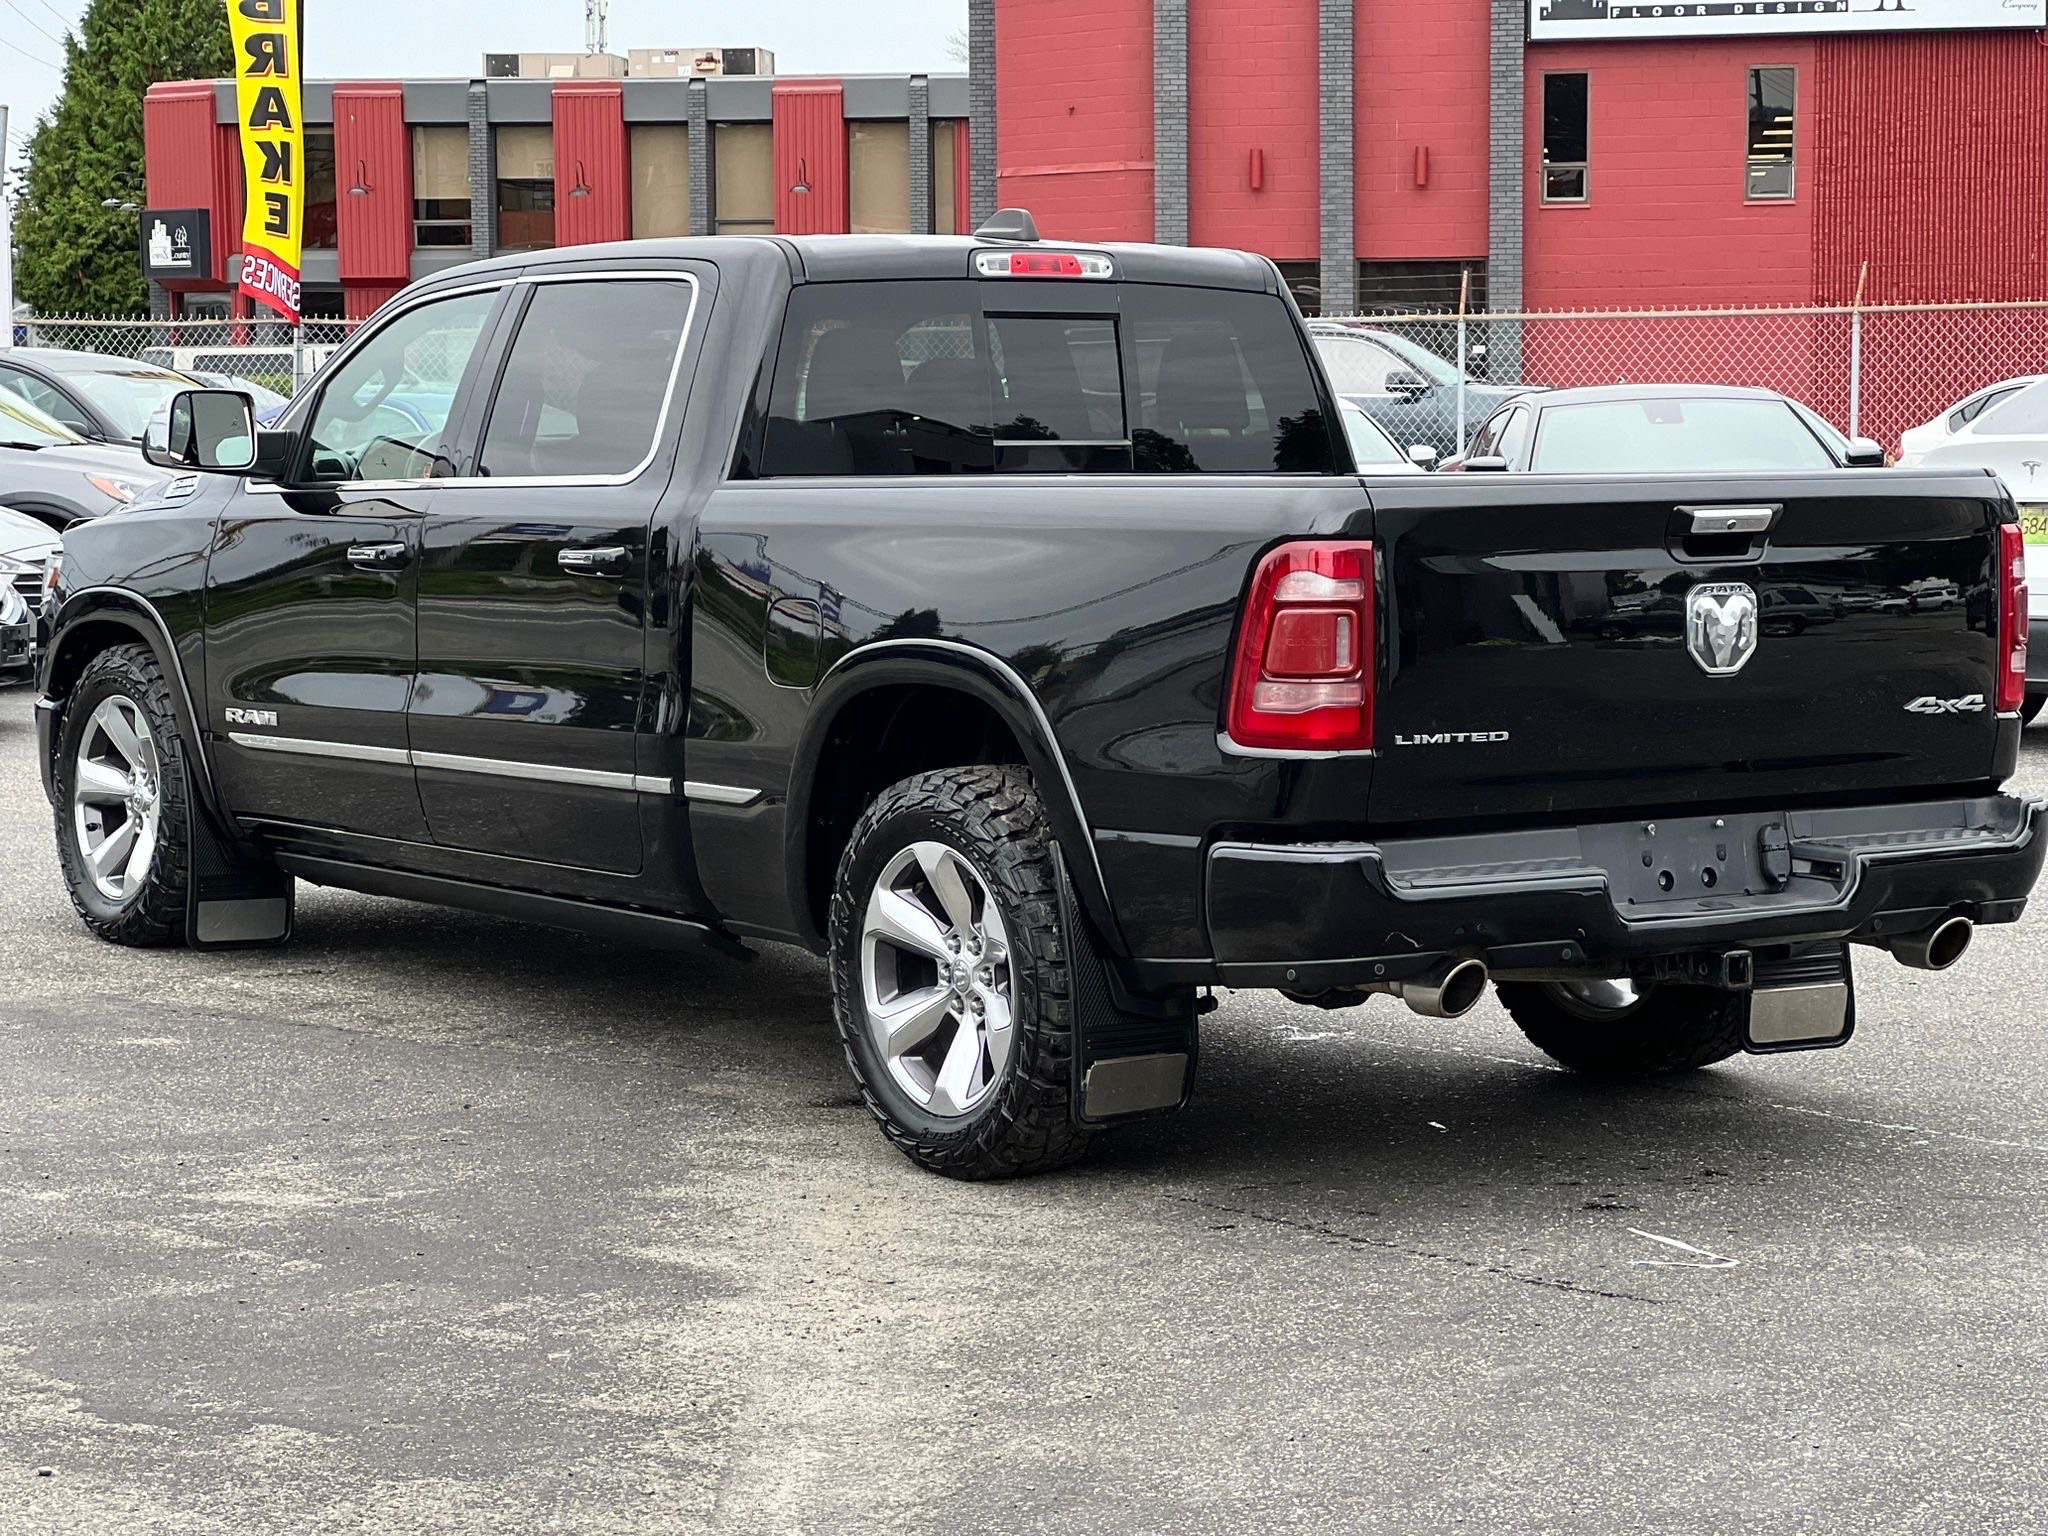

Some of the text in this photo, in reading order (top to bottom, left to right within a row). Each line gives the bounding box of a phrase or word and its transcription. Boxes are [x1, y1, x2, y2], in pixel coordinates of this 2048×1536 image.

[1612, 6, 1706, 18] FLOOR
[1734, 1, 1846, 14] DESIGN
[1703, 585, 1742, 593] RAM
[225, 707, 278, 727] RAM
[1394, 731, 1510, 745] LIMITED
